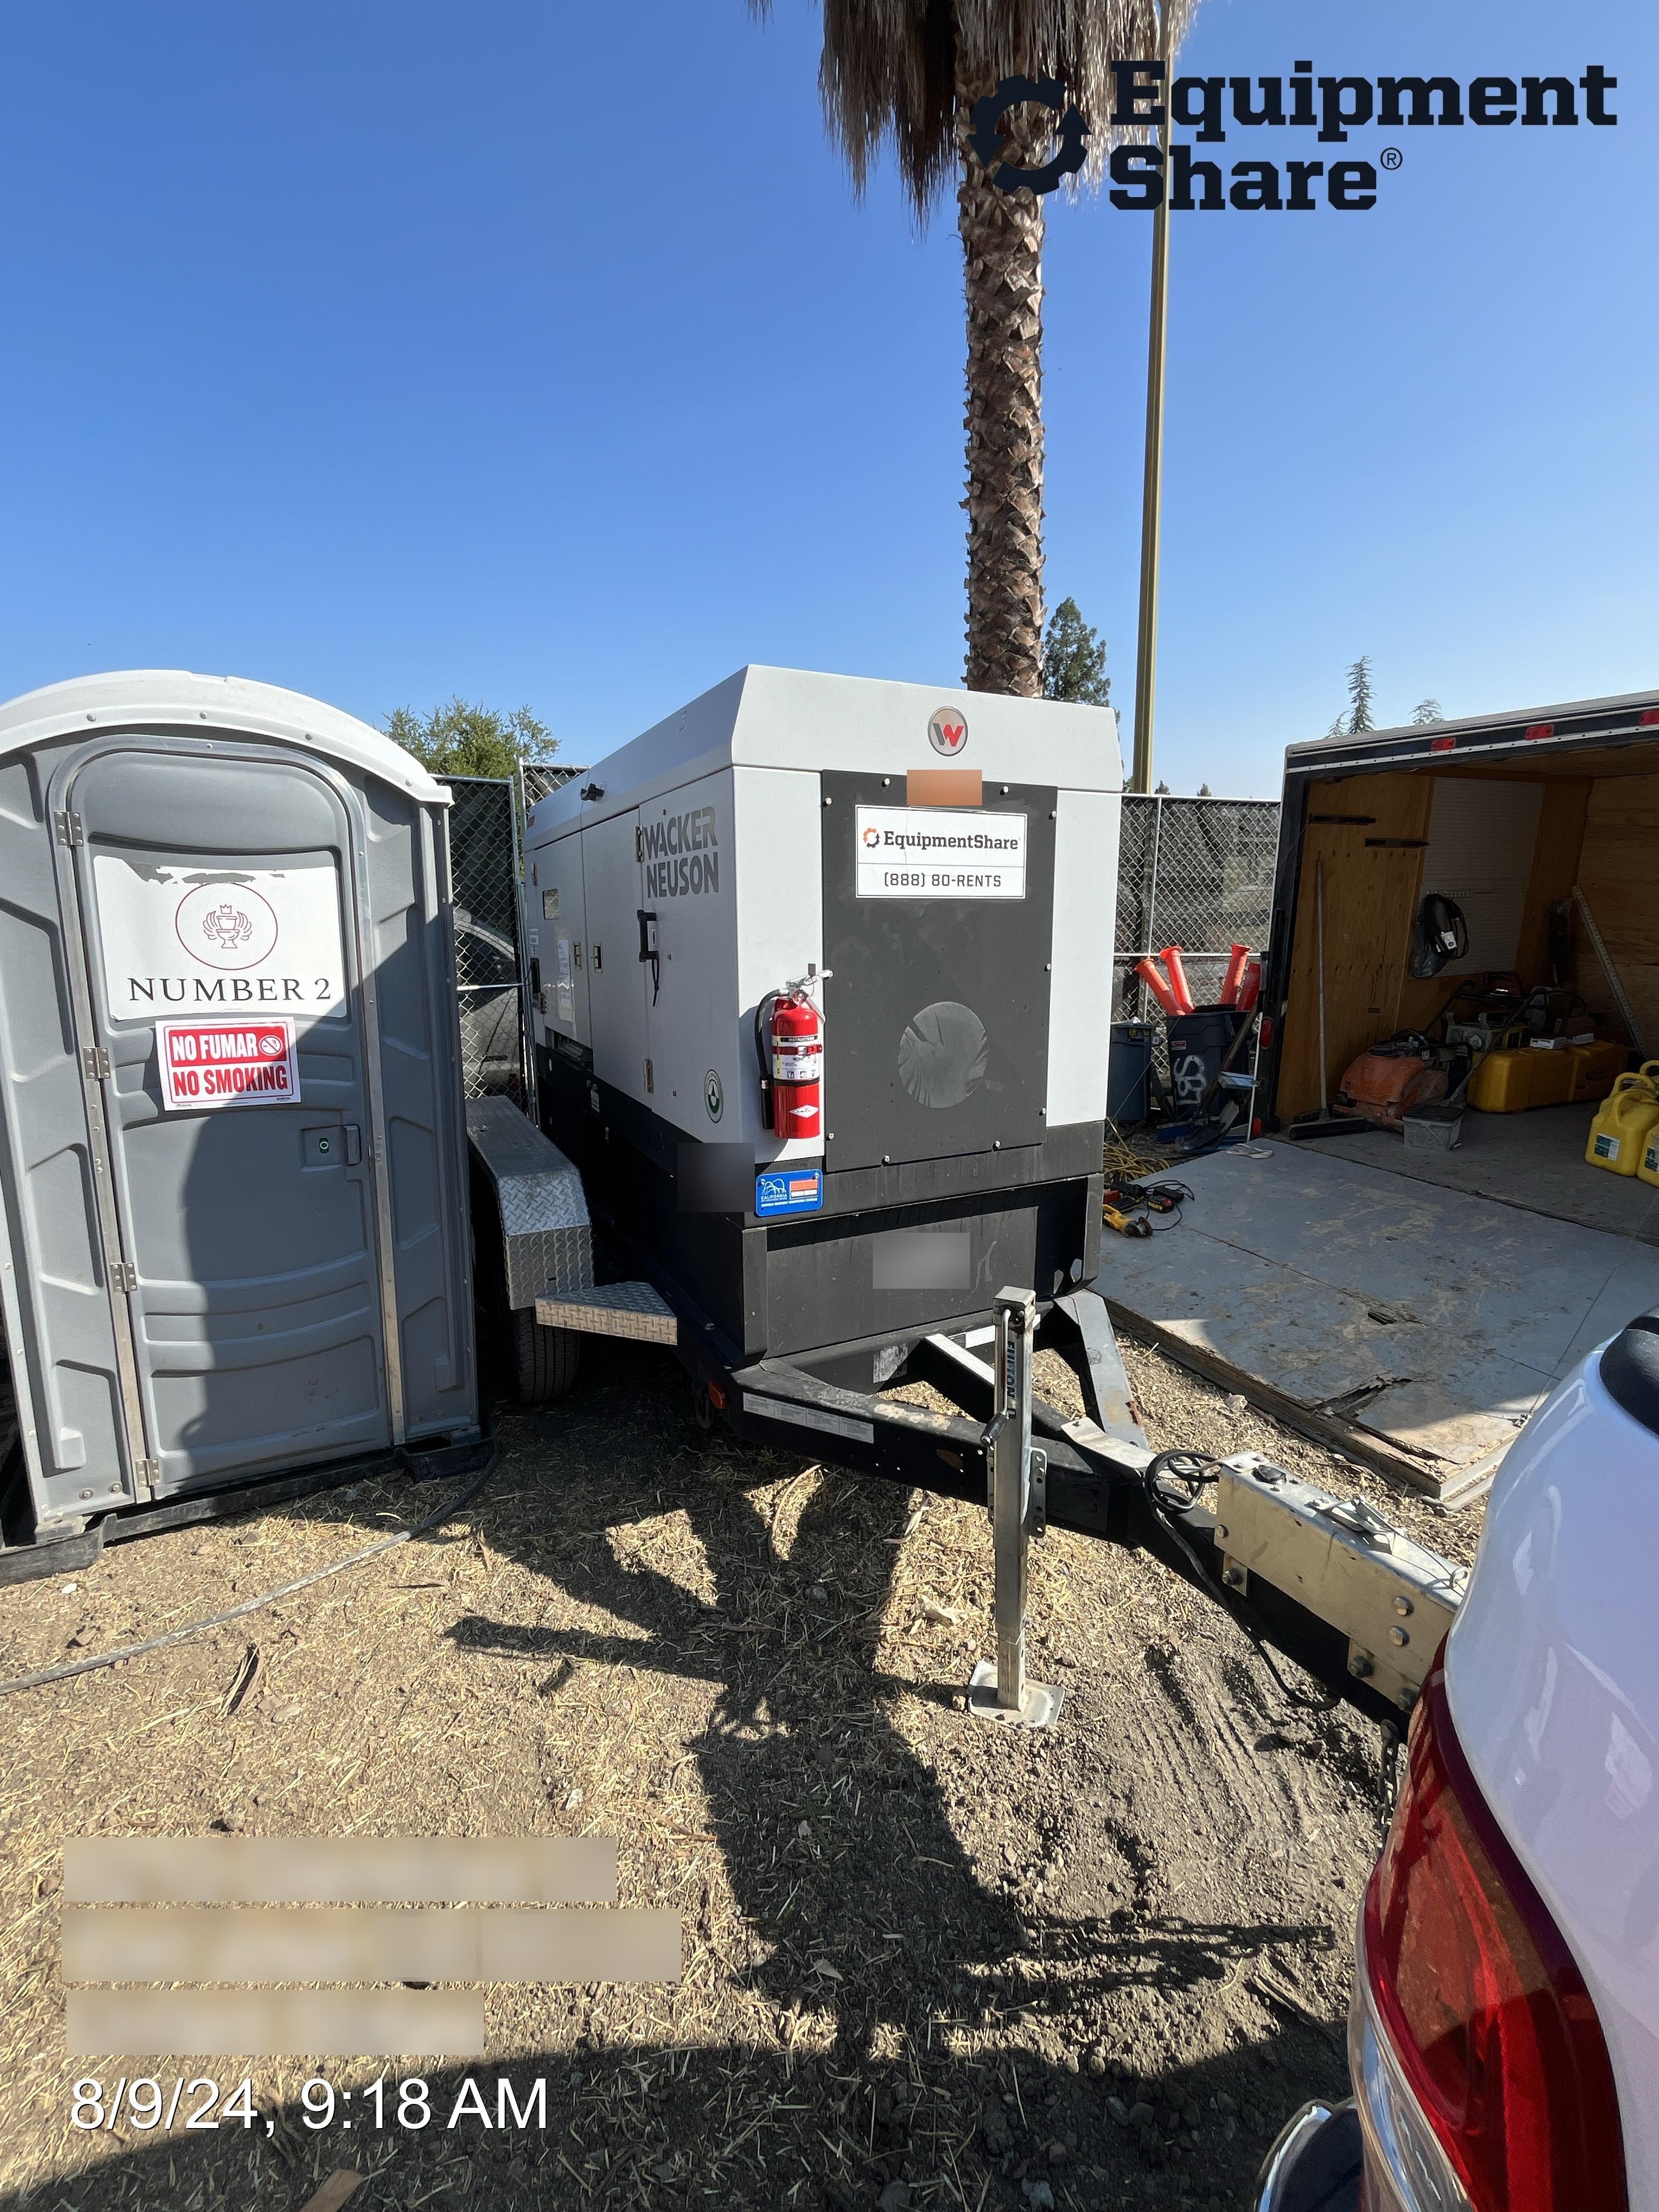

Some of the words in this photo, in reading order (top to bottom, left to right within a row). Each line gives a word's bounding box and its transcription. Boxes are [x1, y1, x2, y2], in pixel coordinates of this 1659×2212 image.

[644, 806, 718, 860] WACKER
[884, 831, 1018, 850] EquipmentShare
[646, 852, 719, 899] NEUSON
[884, 872, 925, 887] (888)
[932, 874, 1001, 887] 80-RENTS
[127, 978, 304, 1001] NUMBER
[314, 978, 331, 1000] 2
[171, 1035, 198, 1061] NO
[199, 1032, 259, 1060] FUMAR
[173, 1070, 200, 1096] NO
[204, 1065, 288, 1094] SMOKING
